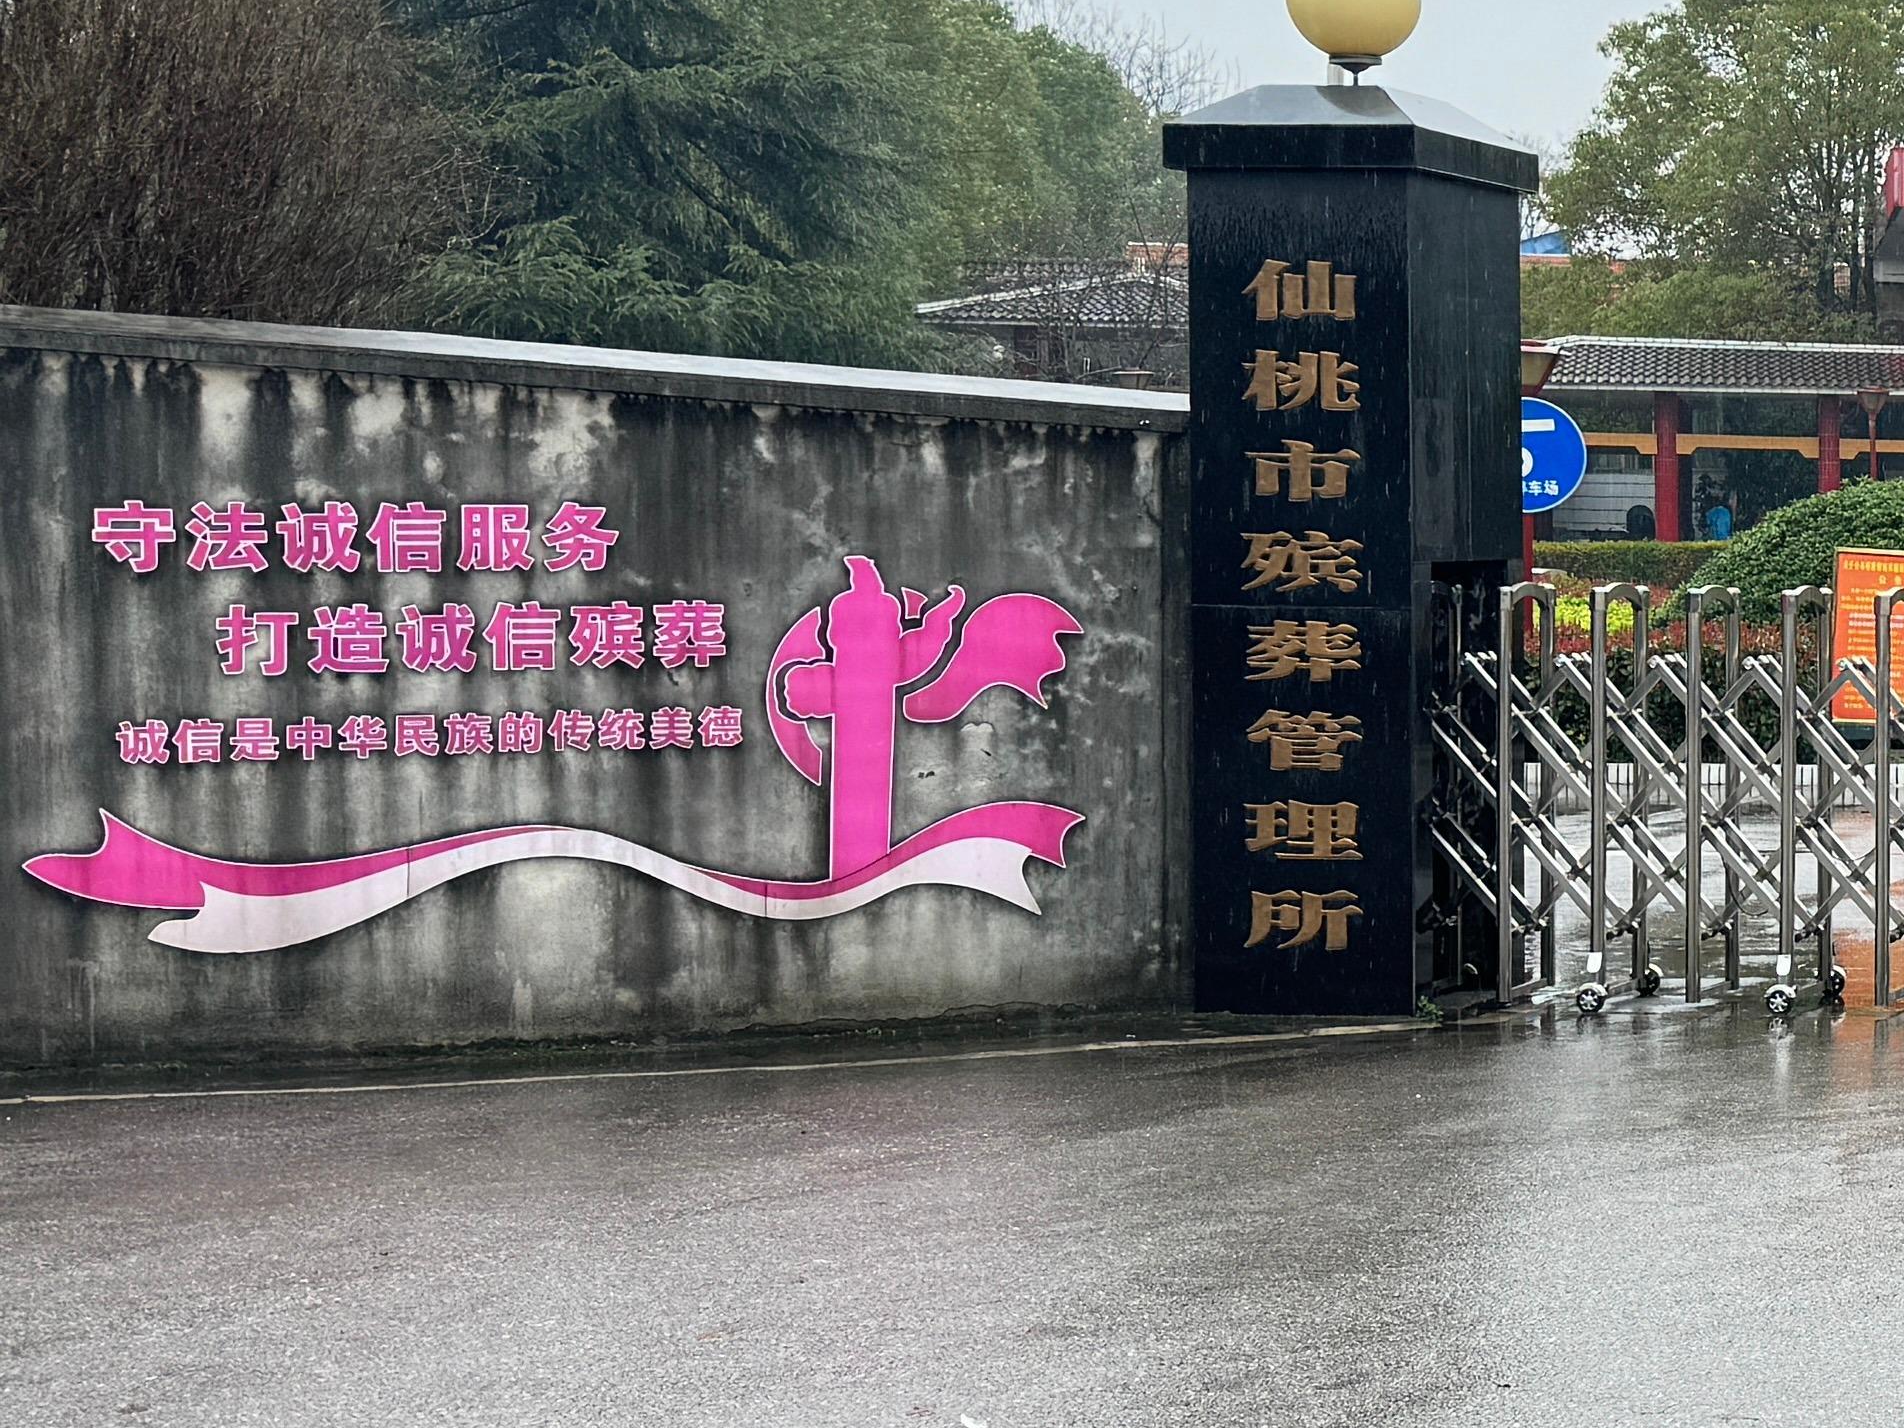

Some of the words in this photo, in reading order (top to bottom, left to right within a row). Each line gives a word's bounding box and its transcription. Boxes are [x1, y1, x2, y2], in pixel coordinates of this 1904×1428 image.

[92, 499, 620, 574] 守法诚信服务
[215, 600, 729, 677] 打造诚信殡葬
[1241, 259, 1364, 951] 仙桃市殡葬管理所
[114, 704, 745, 767] 诚信是中华民族的传统美德
